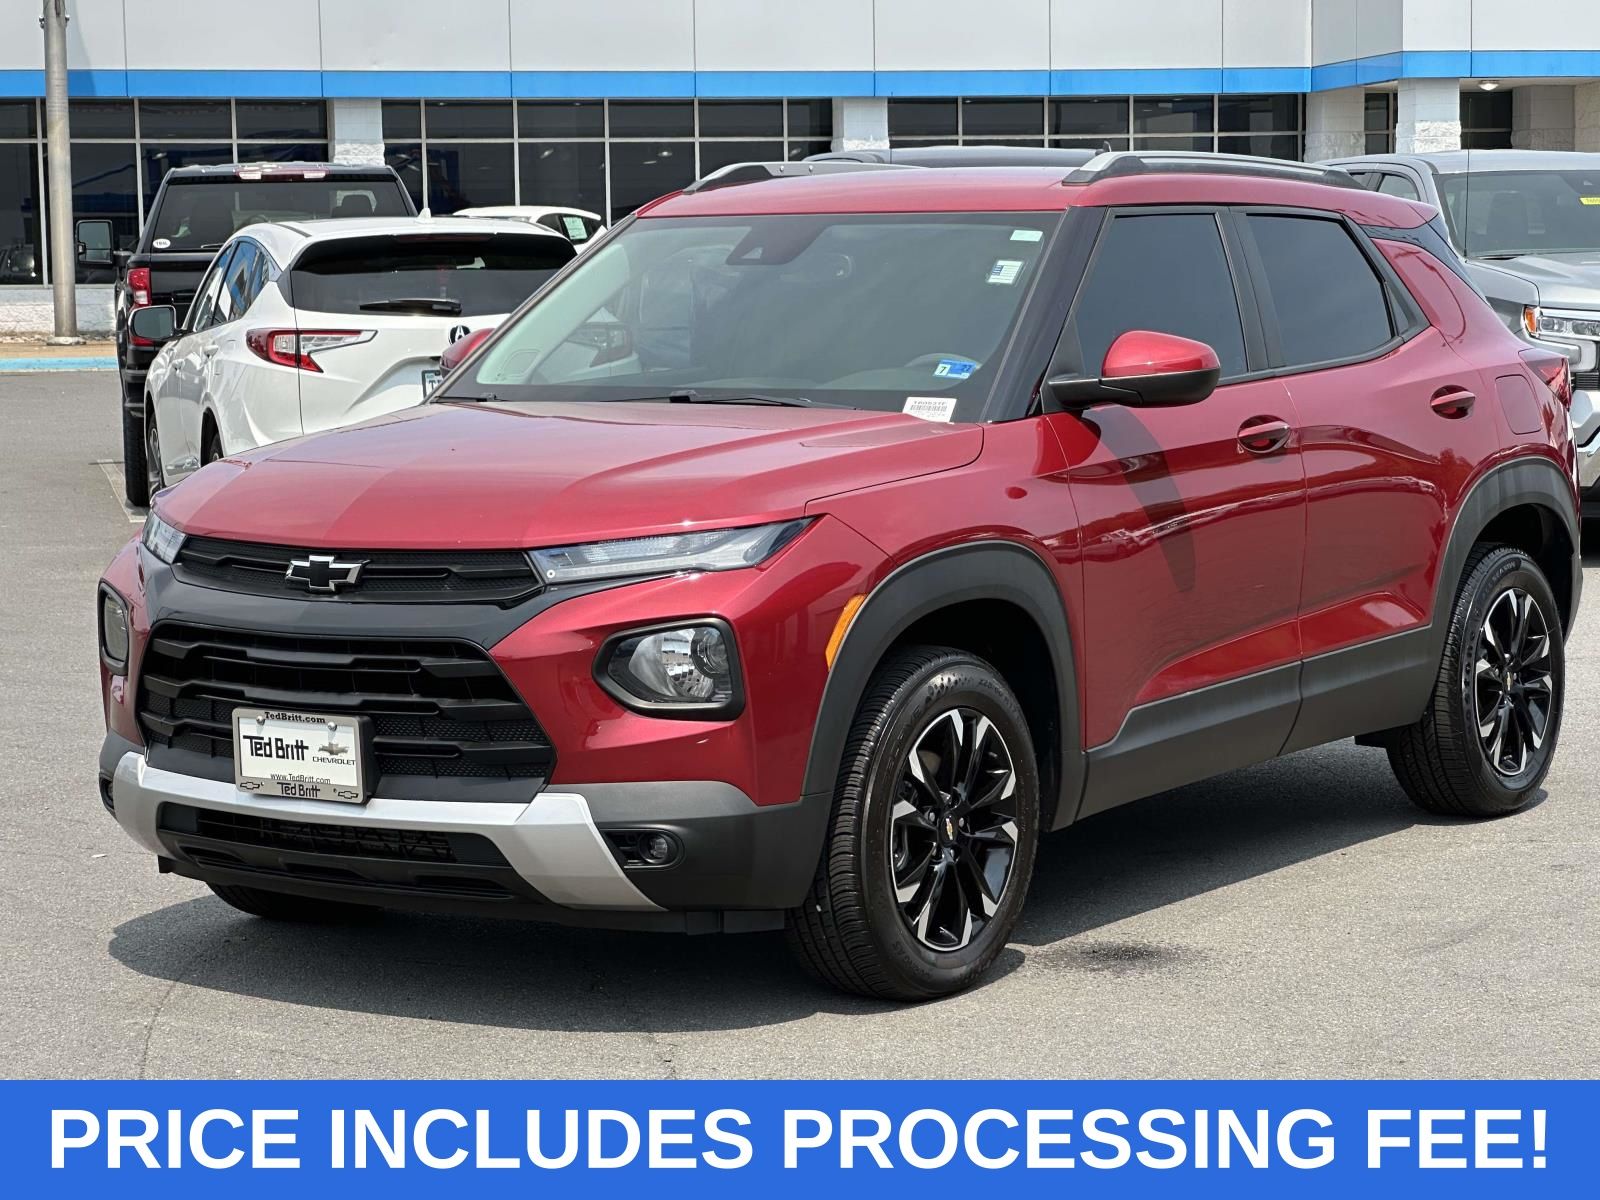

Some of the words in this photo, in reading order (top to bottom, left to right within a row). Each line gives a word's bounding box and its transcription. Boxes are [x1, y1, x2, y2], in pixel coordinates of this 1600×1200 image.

[264, 711, 326, 724] TedBritt.com
[242, 735, 272, 758] Ted
[275, 738, 309, 761] Britt
[312, 756, 356, 766] CHEVROLET
[270, 773, 331, 785] www.TedBritt.com
[277, 782, 297, 796] Ted
[298, 783, 321, 798] Britt
